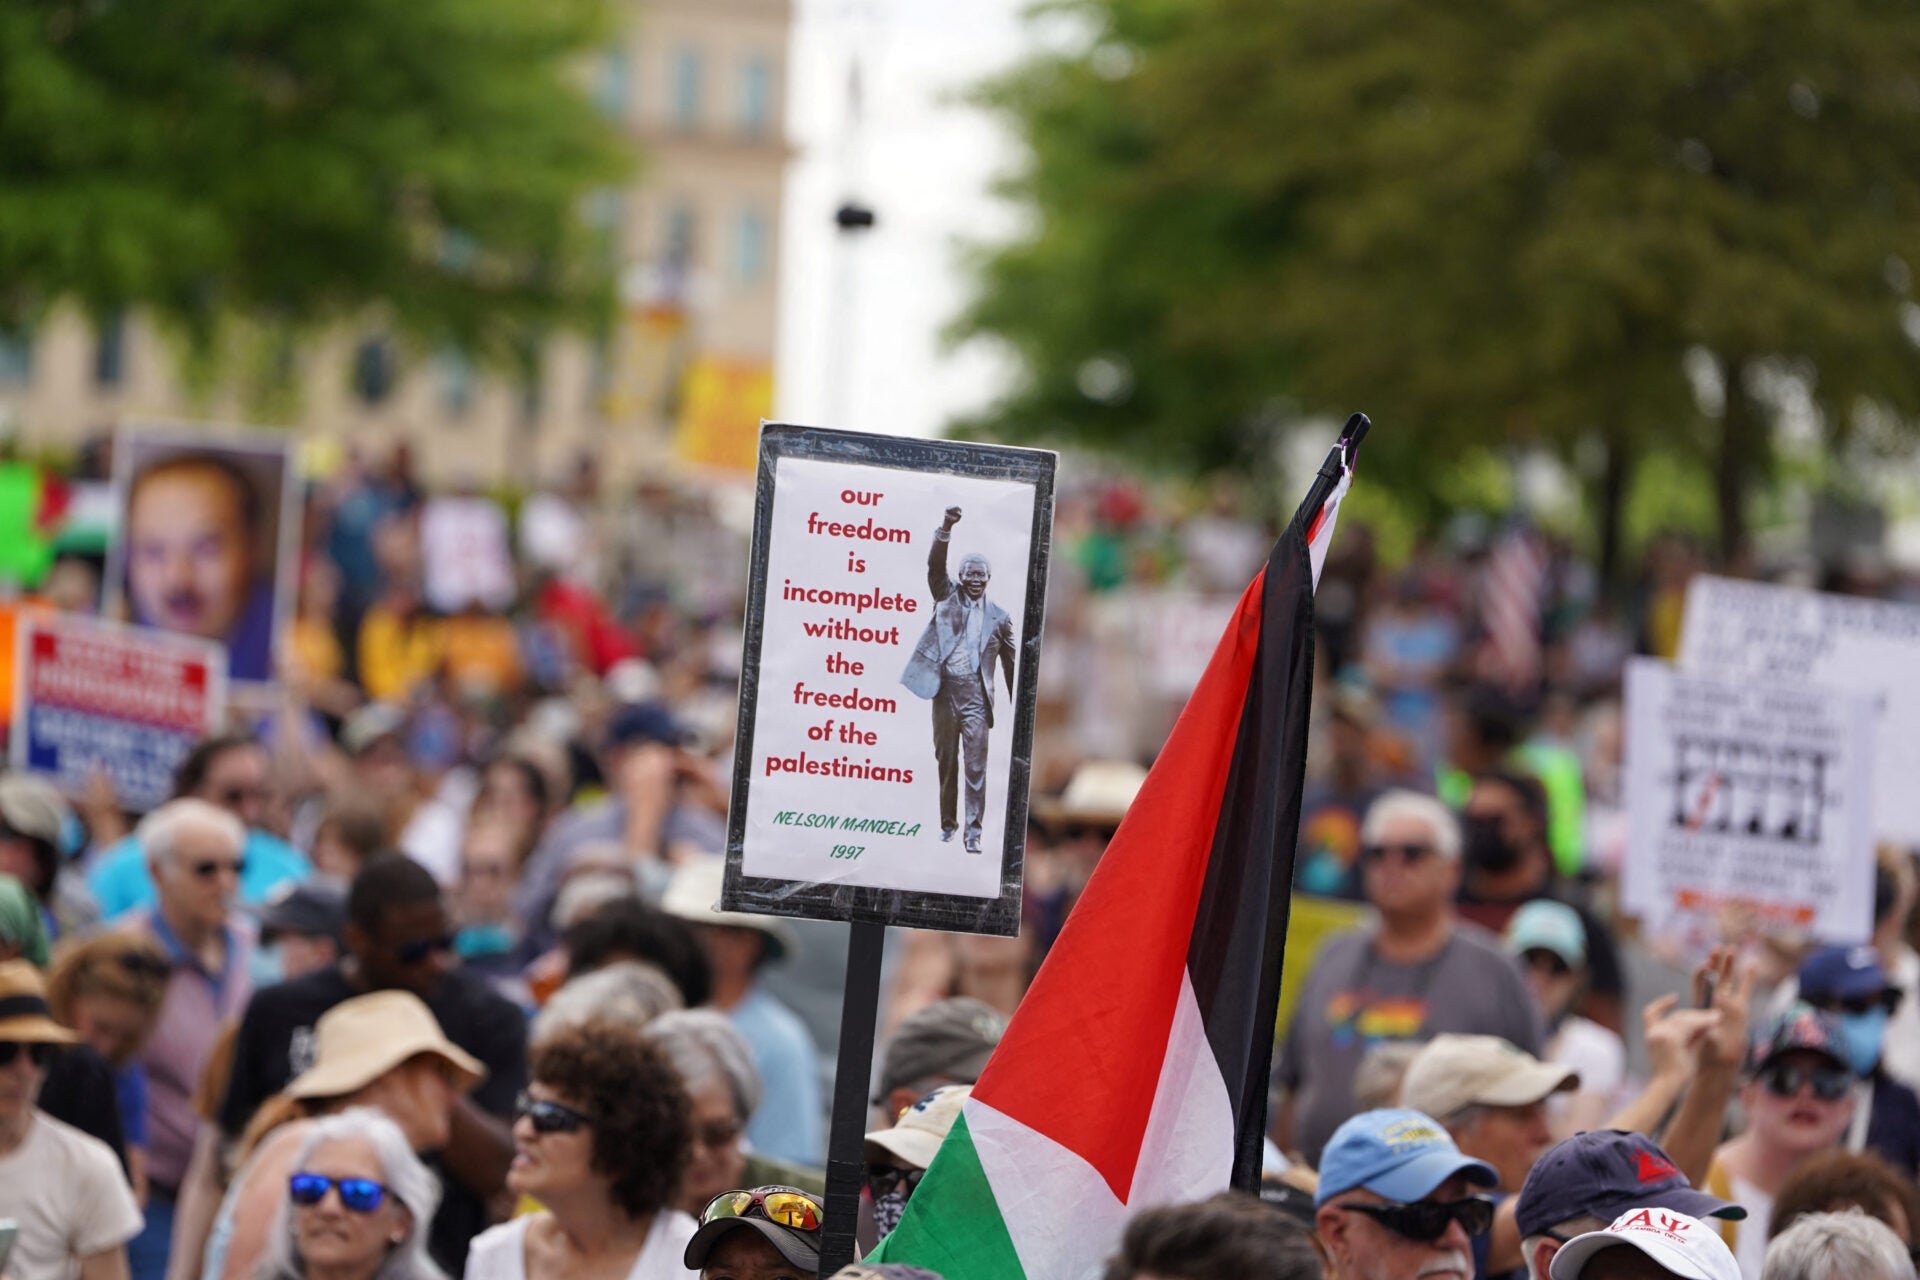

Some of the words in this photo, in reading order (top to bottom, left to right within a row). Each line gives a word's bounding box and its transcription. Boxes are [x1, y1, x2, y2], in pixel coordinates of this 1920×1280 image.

[840, 489, 884, 507] our
[807, 511, 911, 544] freedom
[847, 552, 866, 574] is
[783, 581, 918, 614] incomplete
[803, 617, 899, 646] without
[825, 651, 865, 677] the
[793, 682, 897, 714] freedom
[807, 719, 834, 742] of
[838, 720, 878, 747] the
[765, 752, 914, 785] palestinians
[773, 811, 840, 830] NELSON
[839, 817, 921, 837] MANDELA
[830, 845, 865, 860] 1997
